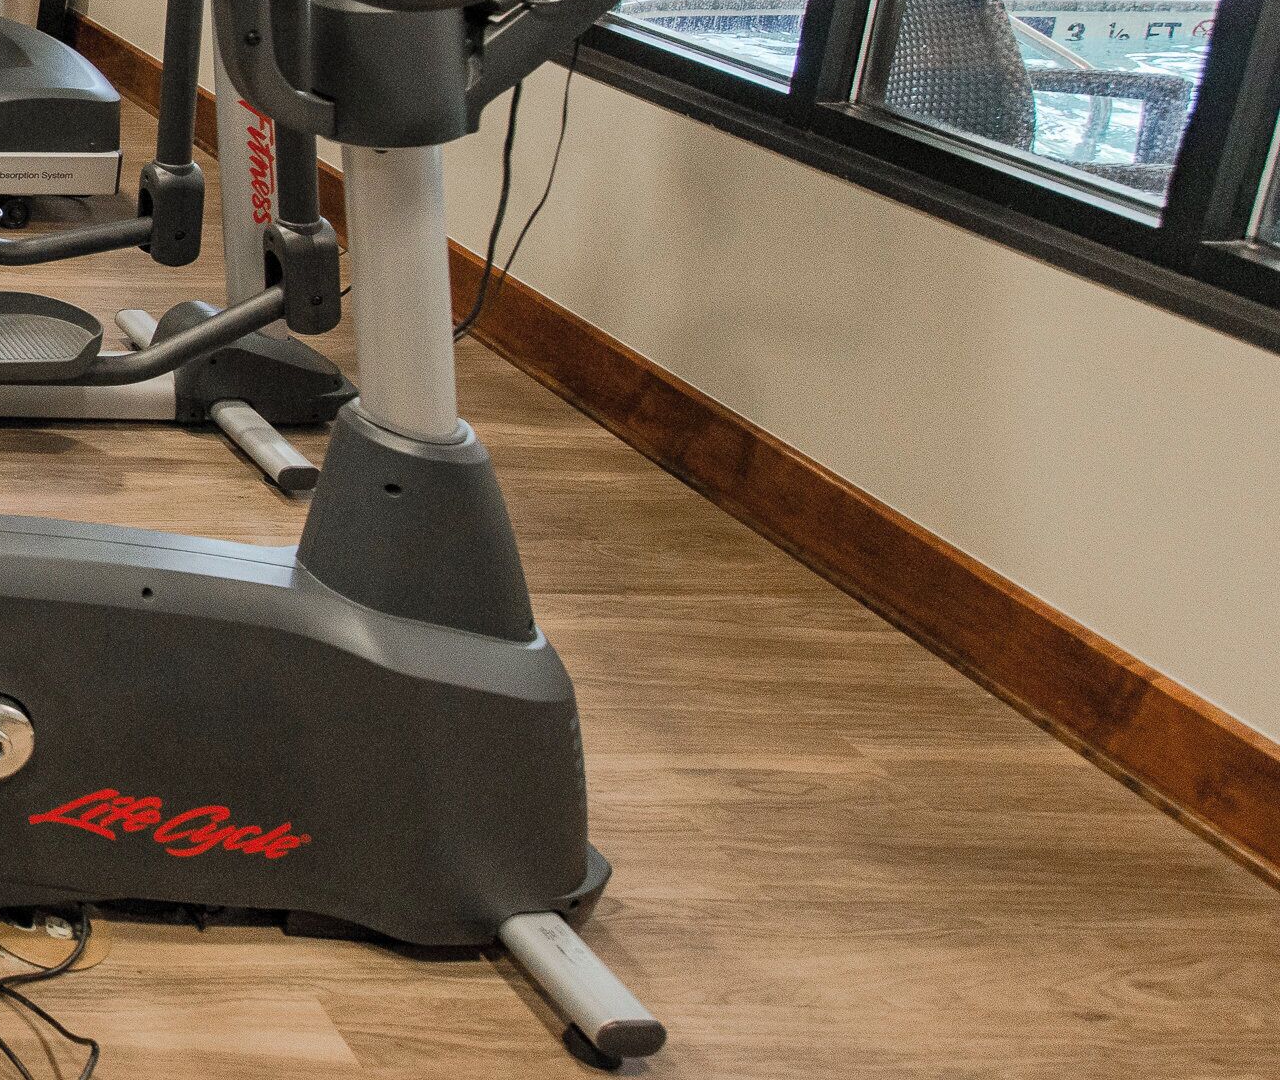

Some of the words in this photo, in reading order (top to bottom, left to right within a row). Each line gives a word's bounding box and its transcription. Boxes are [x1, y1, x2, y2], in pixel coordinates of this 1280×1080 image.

[1065, 22, 1085, 41] 3
[1146, 22, 1182, 40] FT
[41, 172, 73, 180] System
[29, 788, 162, 841] Life
